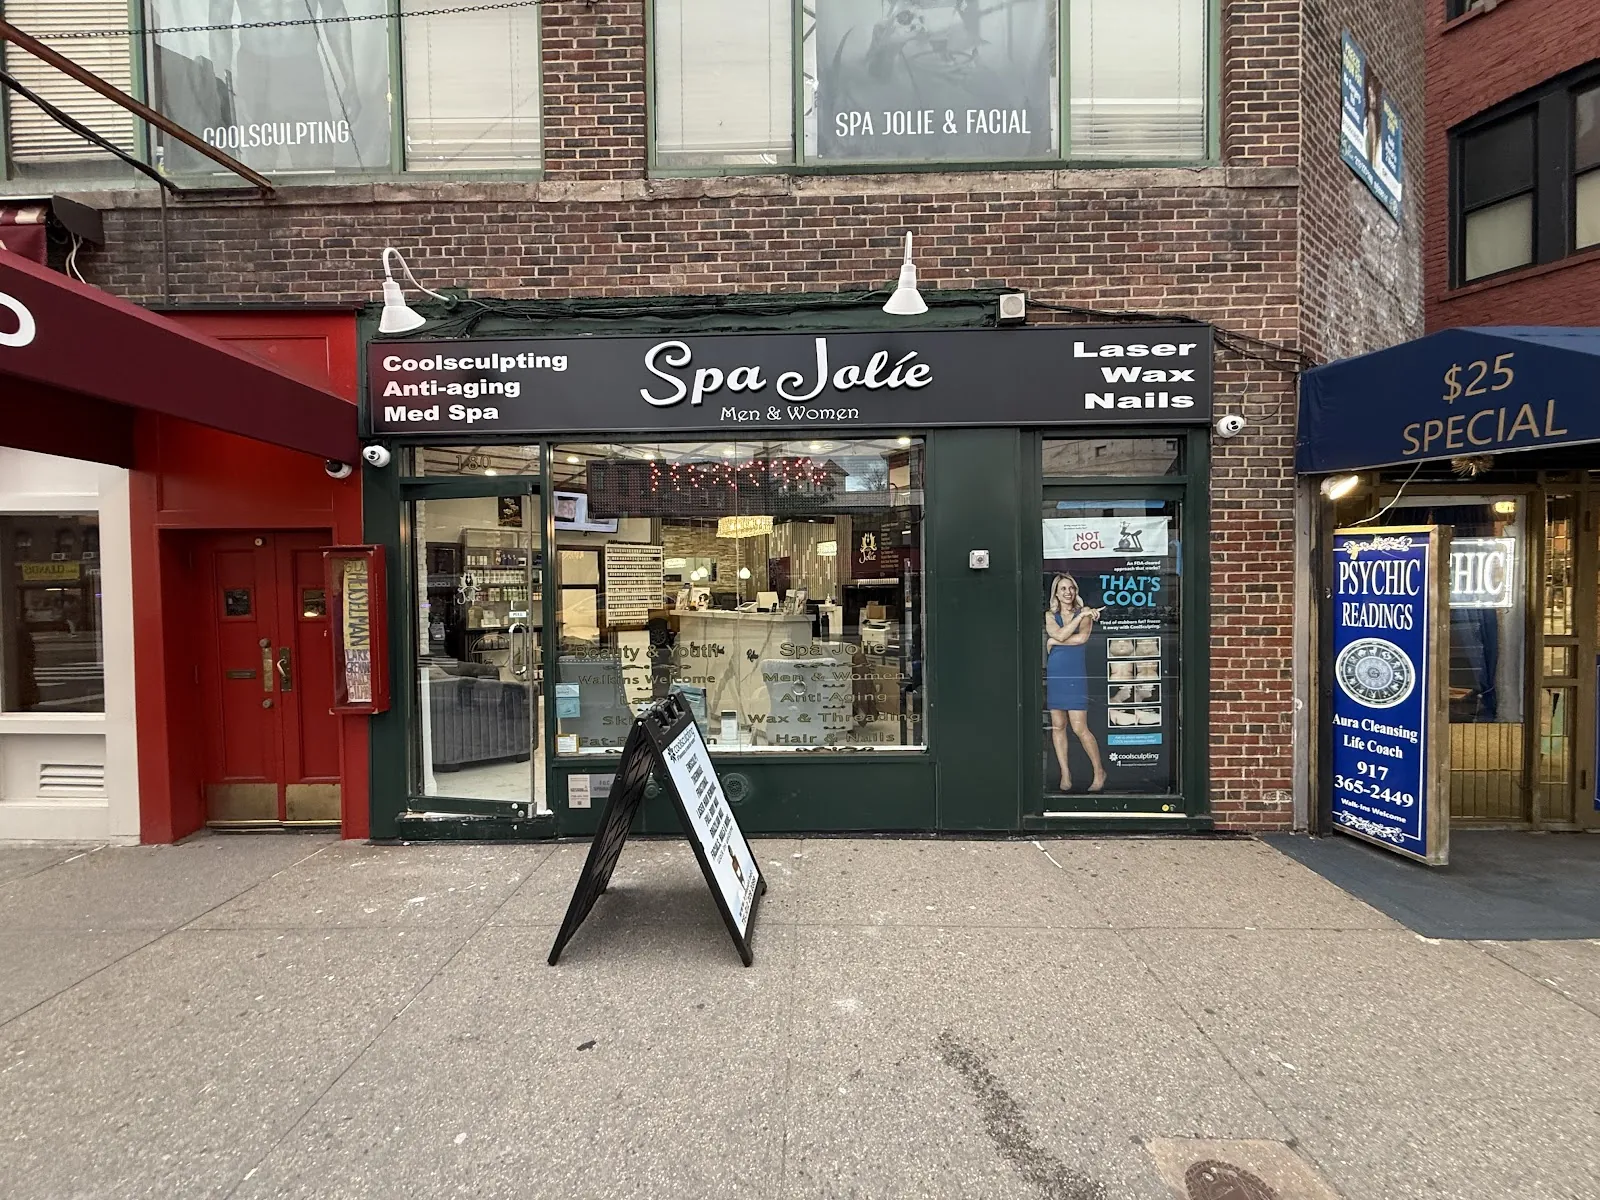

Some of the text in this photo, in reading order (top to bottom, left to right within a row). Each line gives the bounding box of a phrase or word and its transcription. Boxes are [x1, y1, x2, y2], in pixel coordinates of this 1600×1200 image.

[835, 109, 1031, 137] SPA JOLIE & FACIAL
[203, 120, 350, 149] COOLSCULPTING
[1073, 341, 1197, 358] Laser
[383, 352, 568, 372] Coolsculpting
[640, 340, 767, 406] Spa
[1100, 366, 1195, 383] Wax
[1442, 352, 1514, 404] $25
[383, 379, 521, 399] Anti-aging
[1084, 391, 1194, 410] Nails
[384, 404, 499, 423] Med Spa
[720, 404, 859, 423] Men & Women
[1402, 399, 1568, 456] SPECIAL
[456, 455, 491, 470] 180
[1076, 531, 1100, 541] NOT
[1073, 541, 1105, 552] COOL
[1100, 575, 1160, 591] THAT'S
[1338, 559, 1420, 596] PSYCHIC
[1450, 552, 1504, 595] HIC
[1103, 590, 1156, 607] COOL
[1342, 602, 1413, 630] READINGS
[575, 644, 640, 661] Beauty
[646, 644, 659, 659] &
[666, 643, 719, 658] Youth
[780, 640, 886, 659] Spa Jolie
[578, 675, 716, 685] Walkins Welcome
[763, 671, 905, 682] Men & Women
[780, 691, 887, 703] Anti-Aging
[748, 712, 921, 724] Wax & Threading
[776, 732, 895, 744] Hair & Nails
[1332, 713, 1418, 744] Aura Cleansing
[1343, 734, 1403, 759] Life Coach
[1357, 761, 1388, 781] 917
[1334, 775, 1414, 807] 365-2449
[1371, 807, 1406, 823] Welcome
